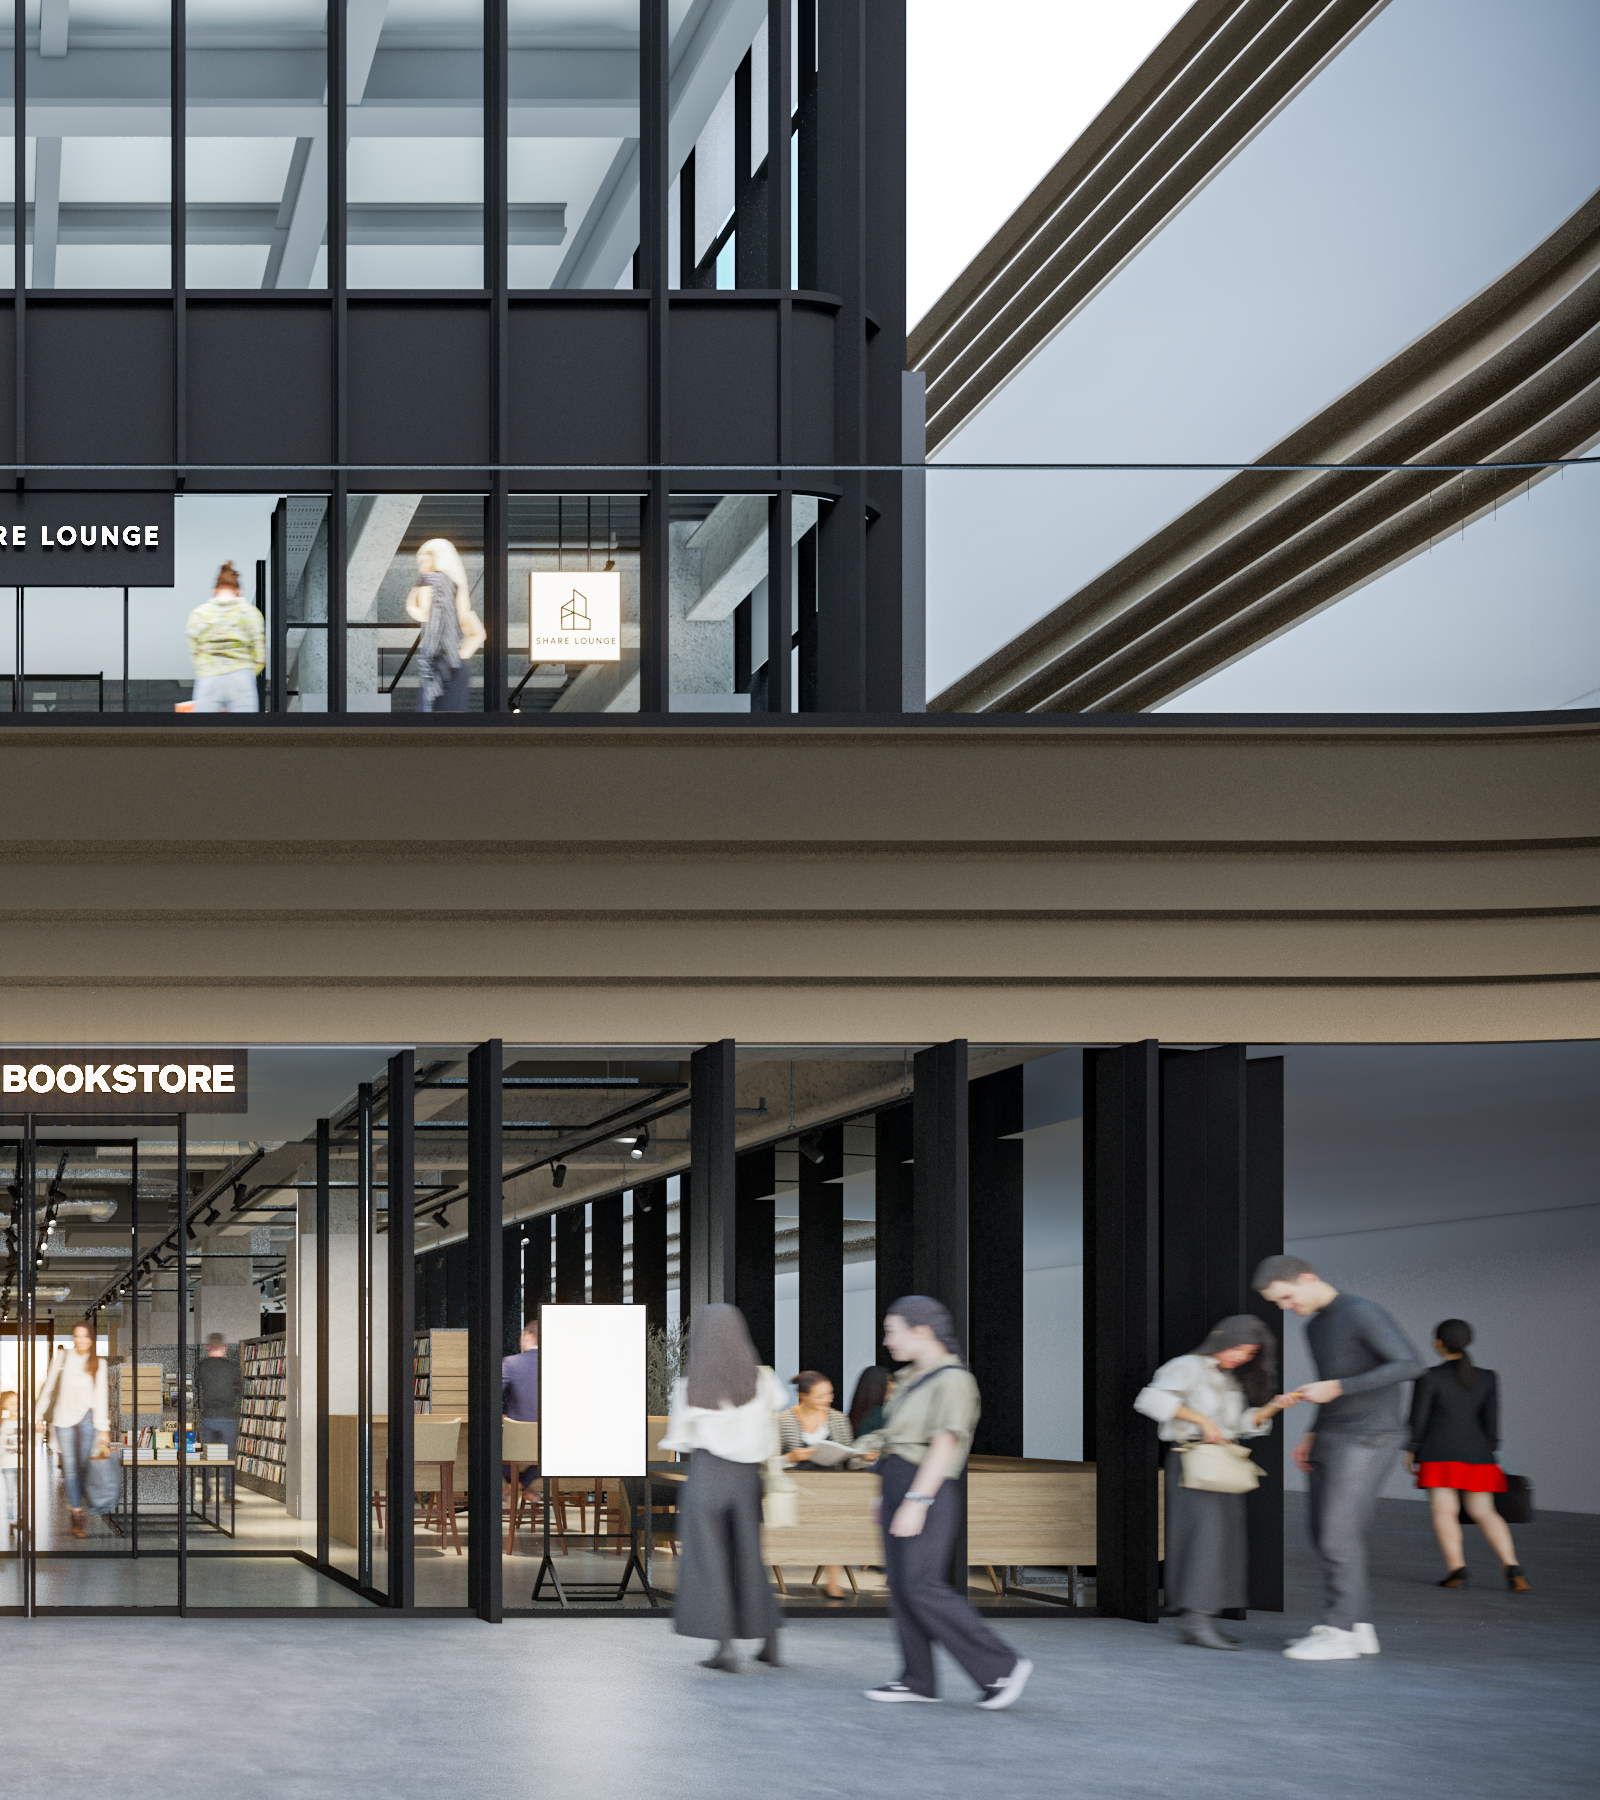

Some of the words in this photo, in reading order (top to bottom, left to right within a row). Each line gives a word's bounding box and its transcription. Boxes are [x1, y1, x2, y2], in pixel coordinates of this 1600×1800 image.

[41, 525, 159, 546] LOUNGE
[535, 637, 570, 645] SHARE
[574, 637, 617, 645] LOUNGE
[2, 1063, 236, 1094] BOOKSTORE
